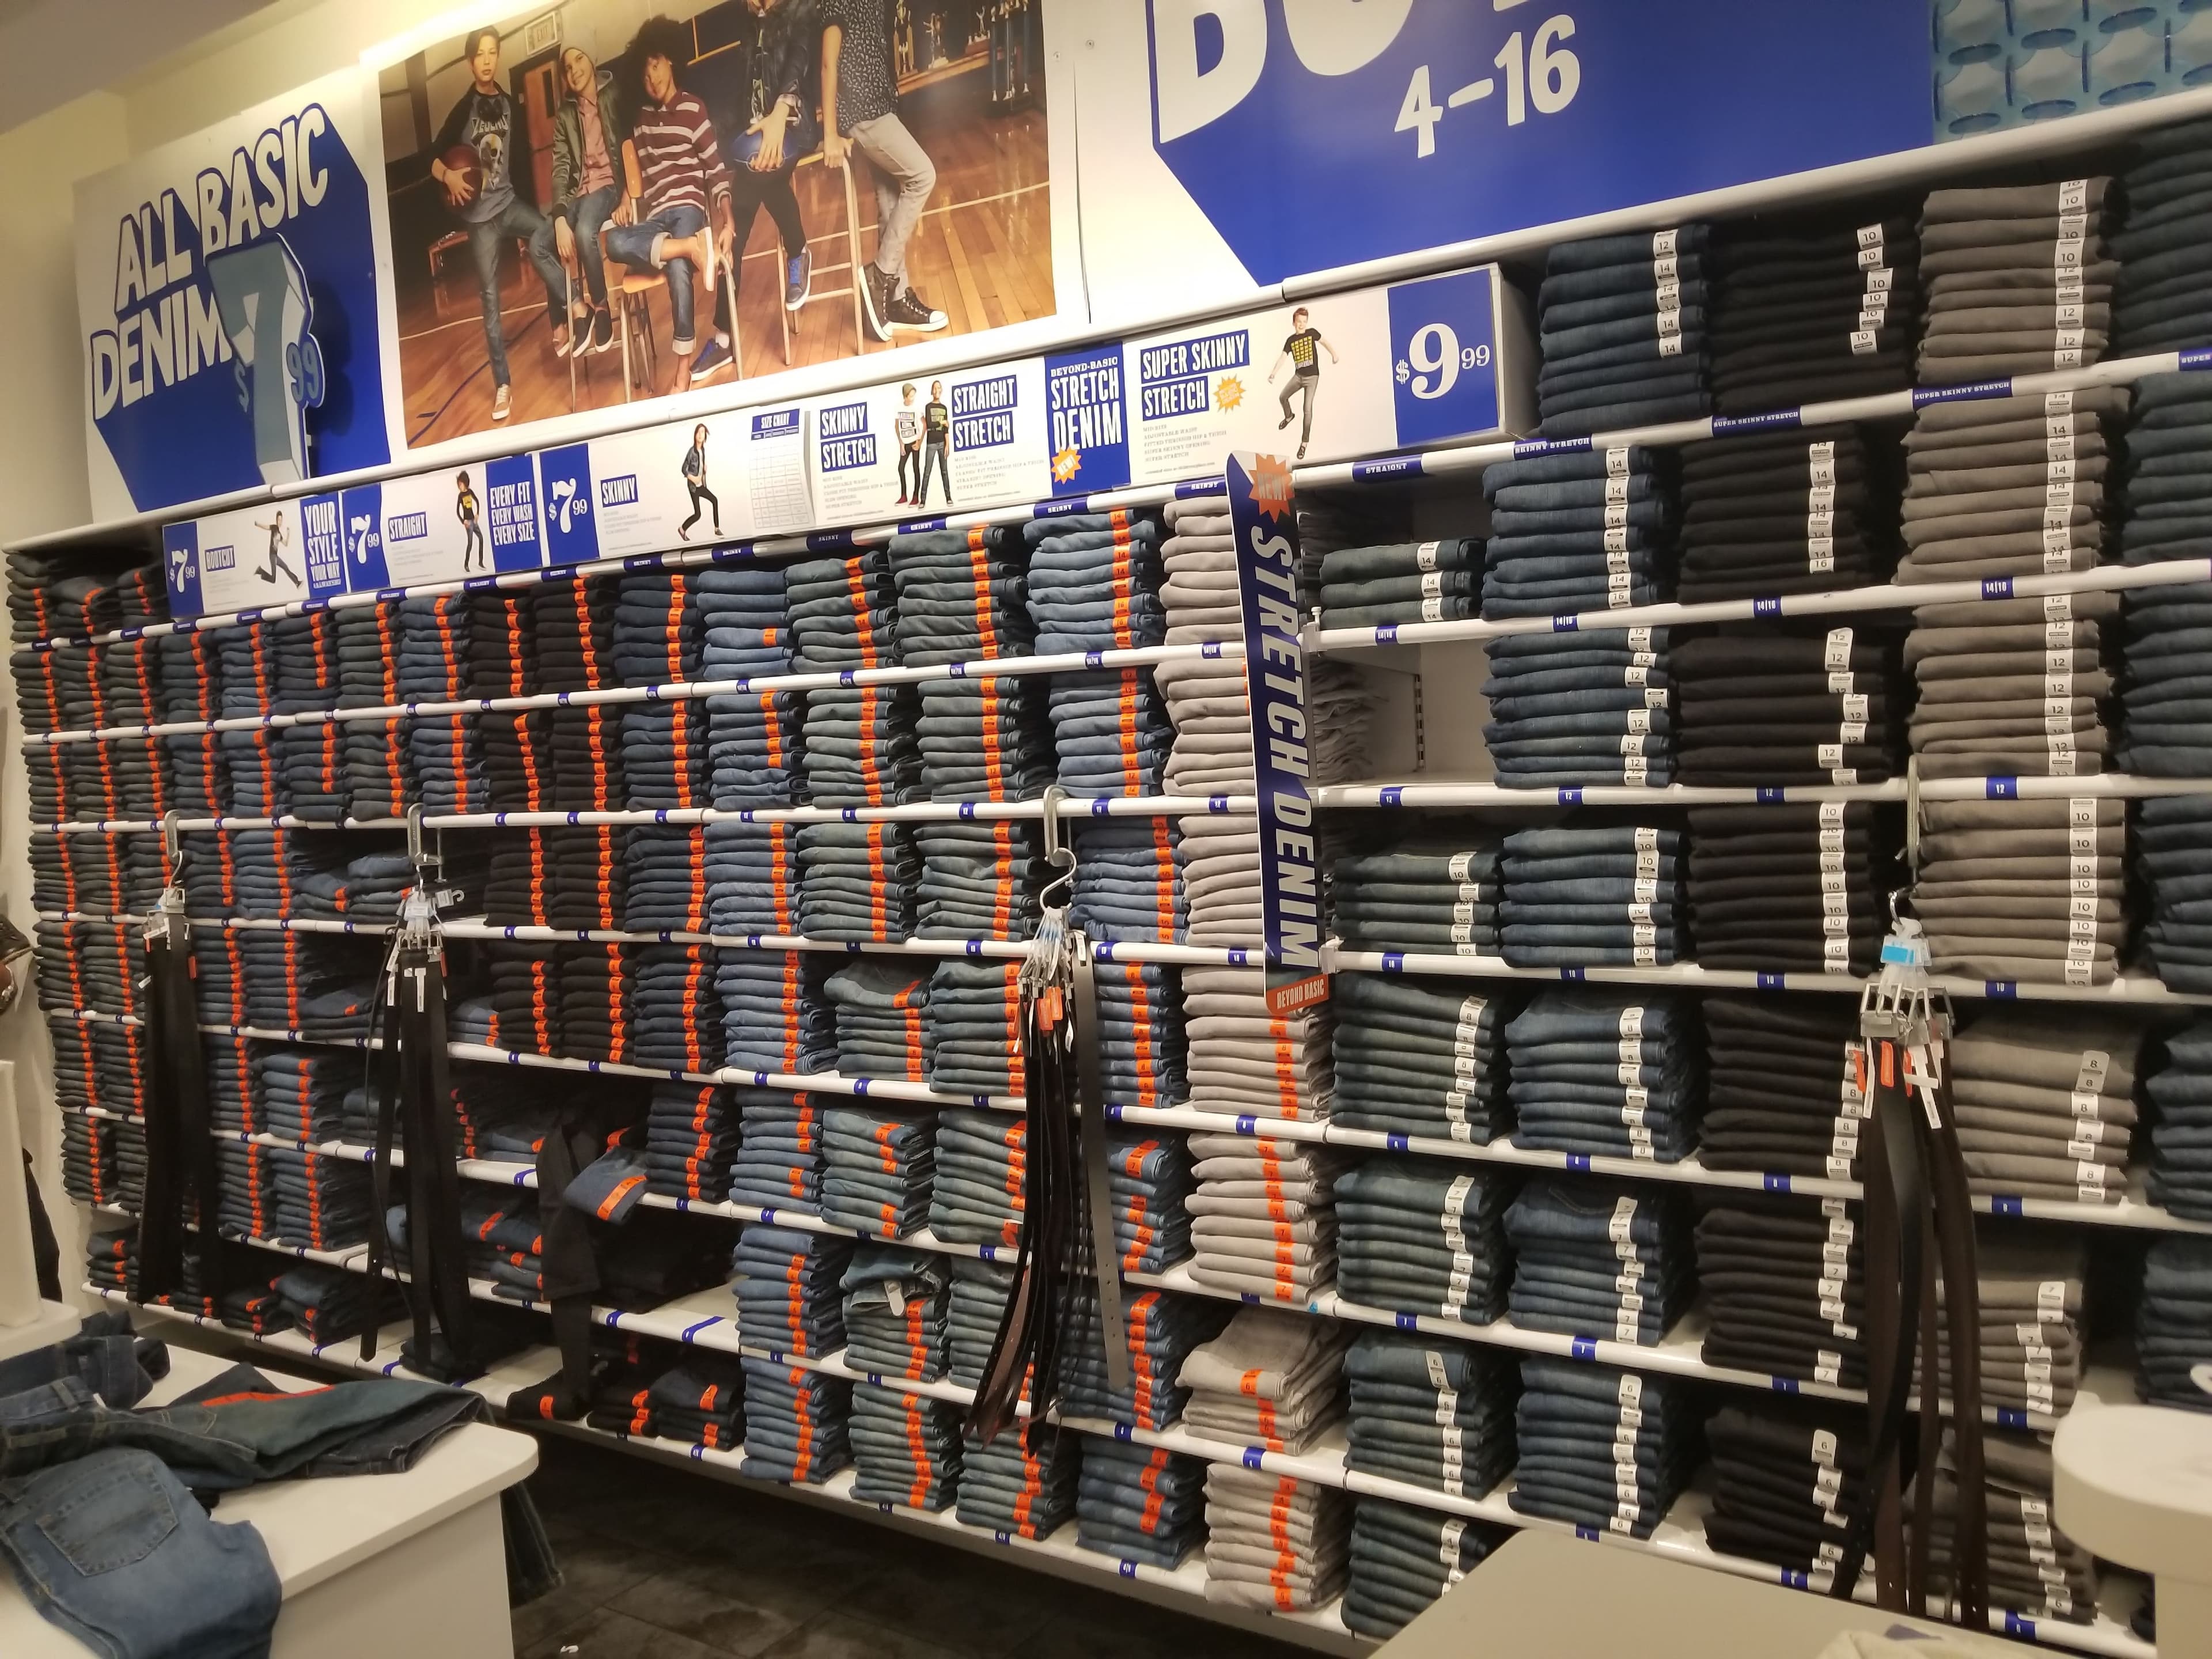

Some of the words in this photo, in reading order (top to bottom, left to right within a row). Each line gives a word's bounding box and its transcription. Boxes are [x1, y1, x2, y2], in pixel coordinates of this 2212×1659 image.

[1395, 14, 1581, 158] 4-16
[2065, 196, 2079, 205] 10
[116, 194, 192, 311] ALL
[198, 105, 328, 258] BASIC
[1863, 231, 1876, 242] 10
[1659, 241, 1669, 250] 12
[1863, 251, 1876, 261] 10
[2061, 253, 2075, 263] 10
[1659, 263, 1670, 273] 14
[1872, 279, 1885, 289] 10
[1868, 293, 1882, 302] 10
[2063, 307, 2075, 317] 12
[1663, 319, 1674, 329] 14
[1856, 332, 1869, 341] 10
[2062, 336, 2075, 346] 12
[92, 285, 232, 419] DENIM
[1664, 344, 1676, 354] 14
[1143, 345, 1188, 378] SUPER
[1194, 335, 1245, 371] SKINNY
[2062, 353, 2074, 362] 12
[1051, 357, 1118, 377] BEYOND-BASIC
[1051, 369, 1119, 410] STRETCH
[954, 378, 1014, 414] STRAIGHT
[1144, 381, 1205, 418] STRETCH
[821, 405, 865, 436] SKINNY
[955, 415, 1012, 448] STRETCH
[1054, 402, 1122, 451] DENIM
[2052, 425, 2066, 435] 14
[1515, 442, 1547, 454] SKINNY
[1550, 438, 1589, 449] STRETCH
[823, 437, 874, 469] STRETCH
[1366, 463, 1407, 475] STRAIGHT
[1612, 460, 1622, 469] 14
[2054, 465, 2066, 474] 14
[1816, 471, 1827, 479] 14
[490, 484, 516, 508] EVERY
[518, 481, 531, 503] FIT
[602, 477, 635, 504] SKINNY
[1611, 487, 1621, 496] 14
[304, 501, 336, 537] YOUR
[491, 506, 512, 526] EVERY
[513, 503, 533, 522] WASH
[1610, 517, 1621, 525] 14
[389, 514, 426, 540] STRAIGHT
[493, 525, 517, 546] EVERY
[517, 521, 535, 541] SIZE
[308, 533, 339, 565] STYLE
[1421, 556, 1431, 565] 14
[1426, 578, 1435, 586] 14
[1615, 575, 1625, 584] 14
[1613, 592, 1624, 601] 16
[1250, 526, 1309, 779] STRETCH
[1639, 654, 1649, 662] 12
[1832, 654, 1843, 662] 12
[2053, 658, 2065, 666] 12
[1630, 672, 1641, 680] 12
[2052, 684, 2065, 692] 12
[2052, 706, 2064, 714] 12
[1633, 719, 1643, 728] 12
[1626, 742, 1636, 751] 12
[1630, 759, 1641, 767] 12
[2076, 813, 2089, 821] 10
[2076, 840, 2089, 848] 10
[1642, 857, 1653, 865] 10
[2077, 865, 2090, 873] 10
[1272, 790, 1319, 969] DENIM
[2077, 880, 2090, 888] 10
[2077, 903, 2090, 911] 10
[2076, 922, 2089, 930] 10
[1277, 989, 1303, 1009] BEYOND
[1304, 979, 1325, 1003] BASIC
[1624, 1245, 1630, 1253] 7
[1627, 1384, 1633, 1392] 6
